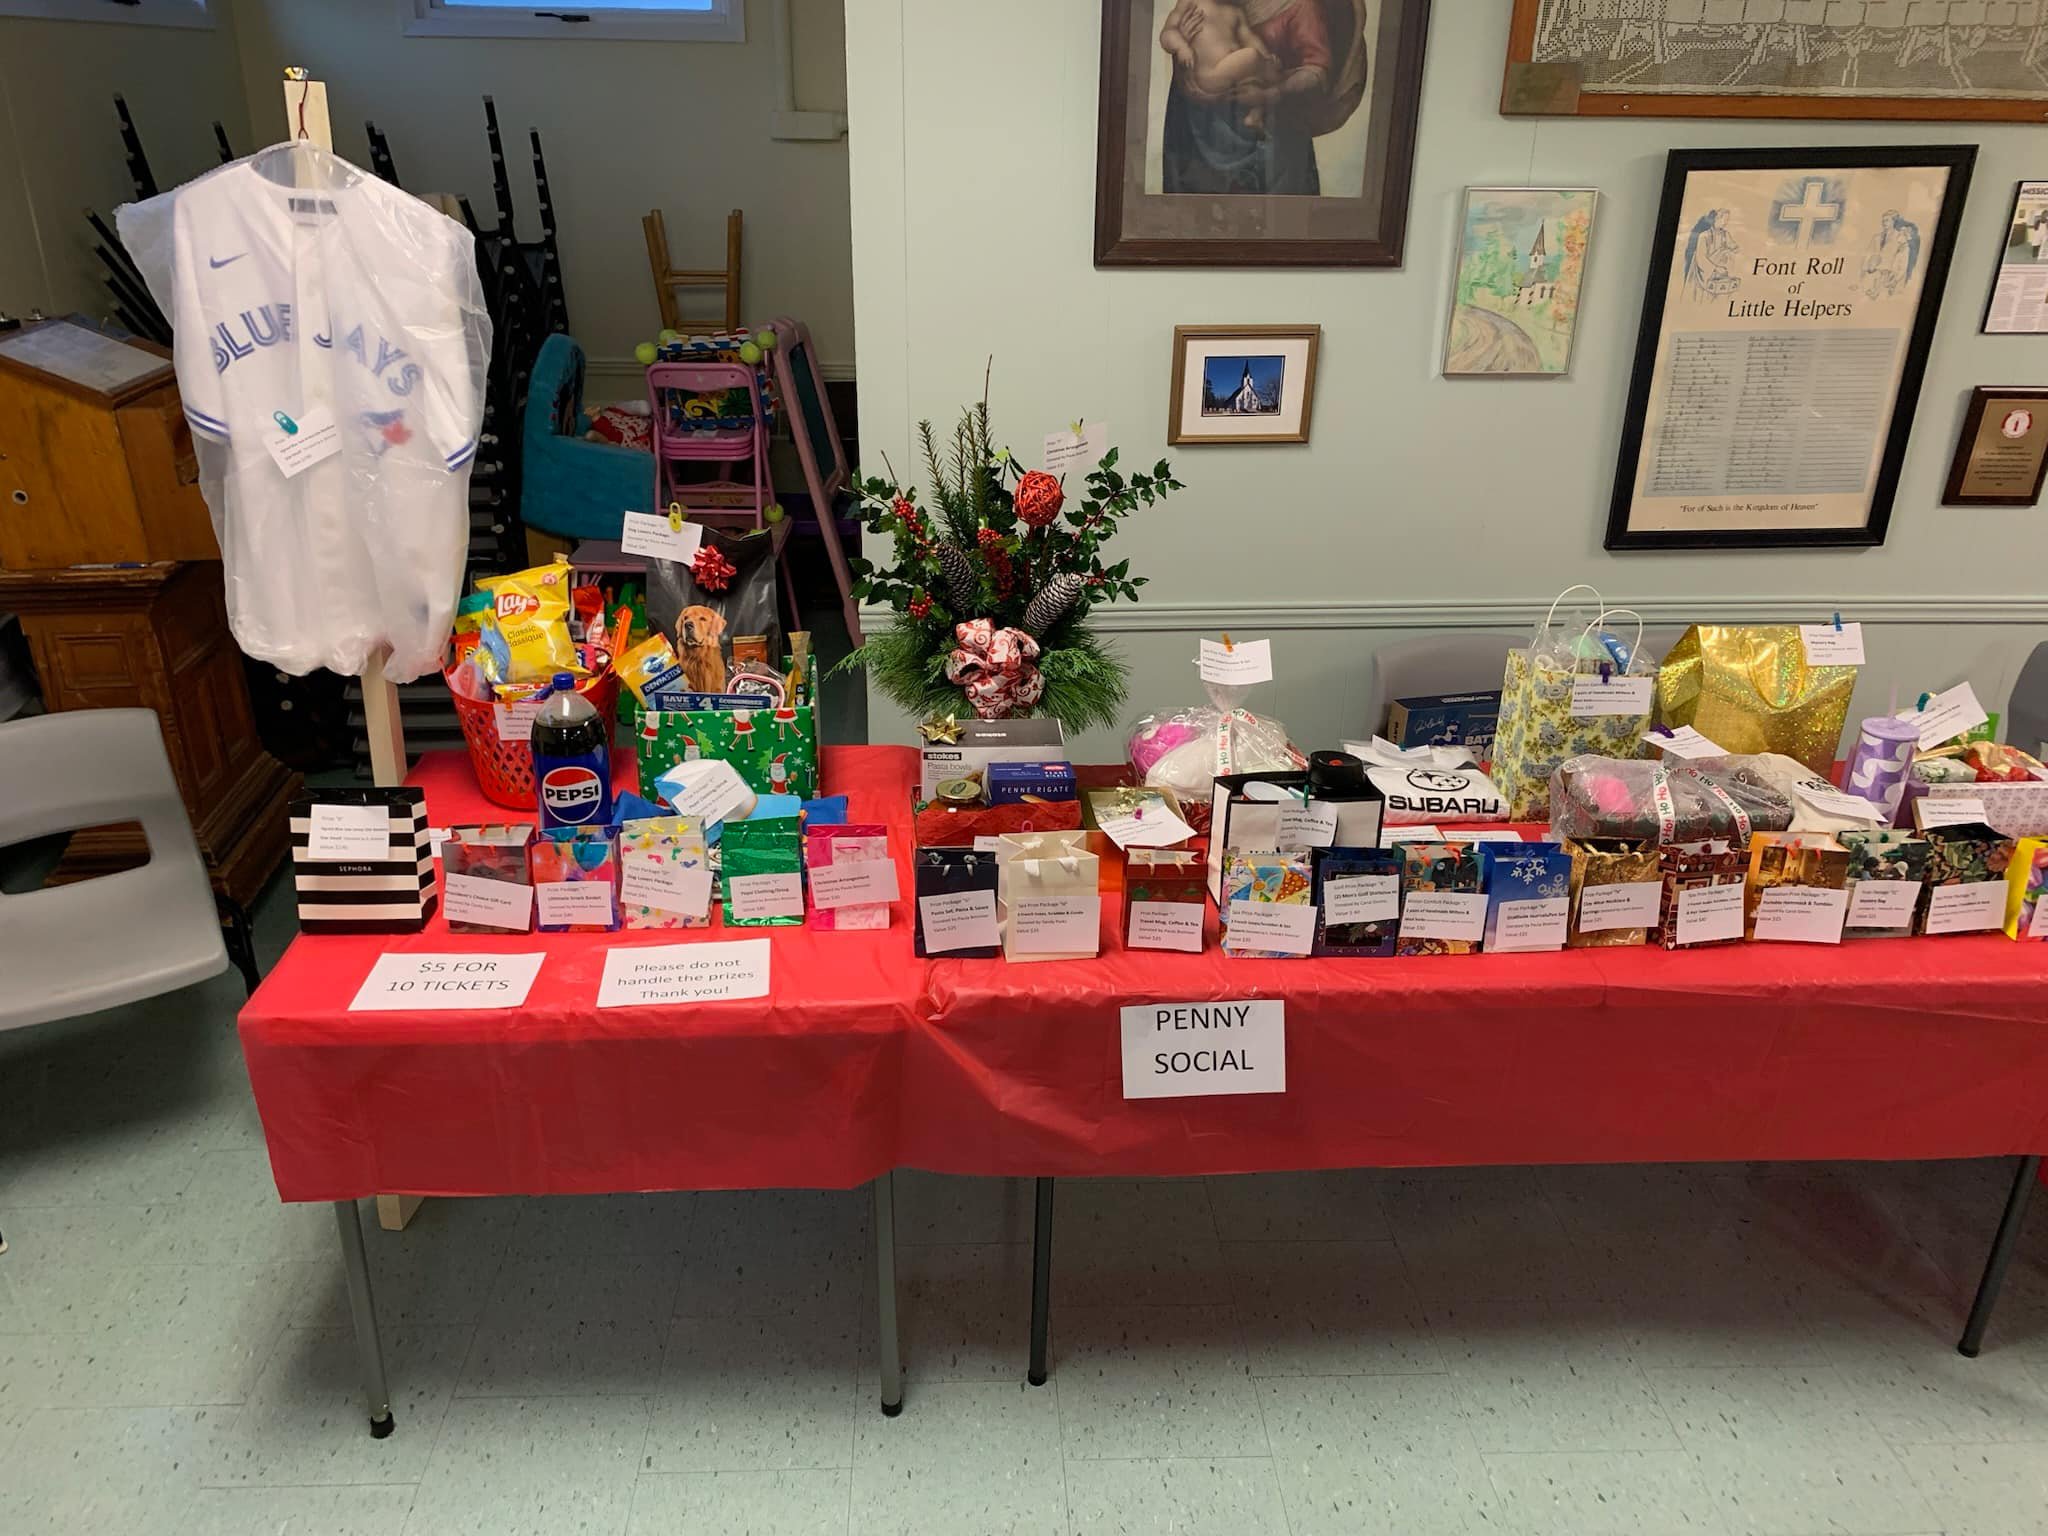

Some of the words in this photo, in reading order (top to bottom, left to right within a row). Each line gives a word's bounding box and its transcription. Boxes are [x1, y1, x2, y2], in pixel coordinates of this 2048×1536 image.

[1752, 258, 1796, 276] Font
[1807, 258, 1845, 276] Roll
[1788, 282, 1804, 295] of
[1728, 300, 1775, 318] Little
[1784, 300, 1853, 320] Helpers
[209, 303, 290, 376] BLUE
[497, 594, 538, 617] Lay
[507, 624, 537, 640] Classic
[509, 631, 545, 648] lassique
[663, 695, 690, 703] SAVE
[928, 752, 960, 760] stokes
[928, 762, 948, 771] Pasta
[950, 762, 972, 771] bowls
[545, 784, 599, 801] PEPSI
[1002, 786, 1031, 794] PENNE
[1037, 785, 1069, 794] RIGATE
[1389, 795, 1499, 814] SUBARU
[418, 961, 445, 974] $5
[452, 961, 497, 973] FOR
[634, 961, 684, 973] Please
[690, 960, 710, 970] do
[714, 960, 742, 970] not
[385, 980, 416, 992] 10
[423, 980, 511, 992] TICKETS
[617, 974, 671, 987] handle
[678, 973, 703, 985] the
[709, 970, 755, 983] prizes
[640, 989, 689, 1000] Thank
[694, 986, 730, 1000] you!
[1156, 1006, 1250, 1031] PENNY
[1155, 1049, 1254, 1074] SOCIAL
